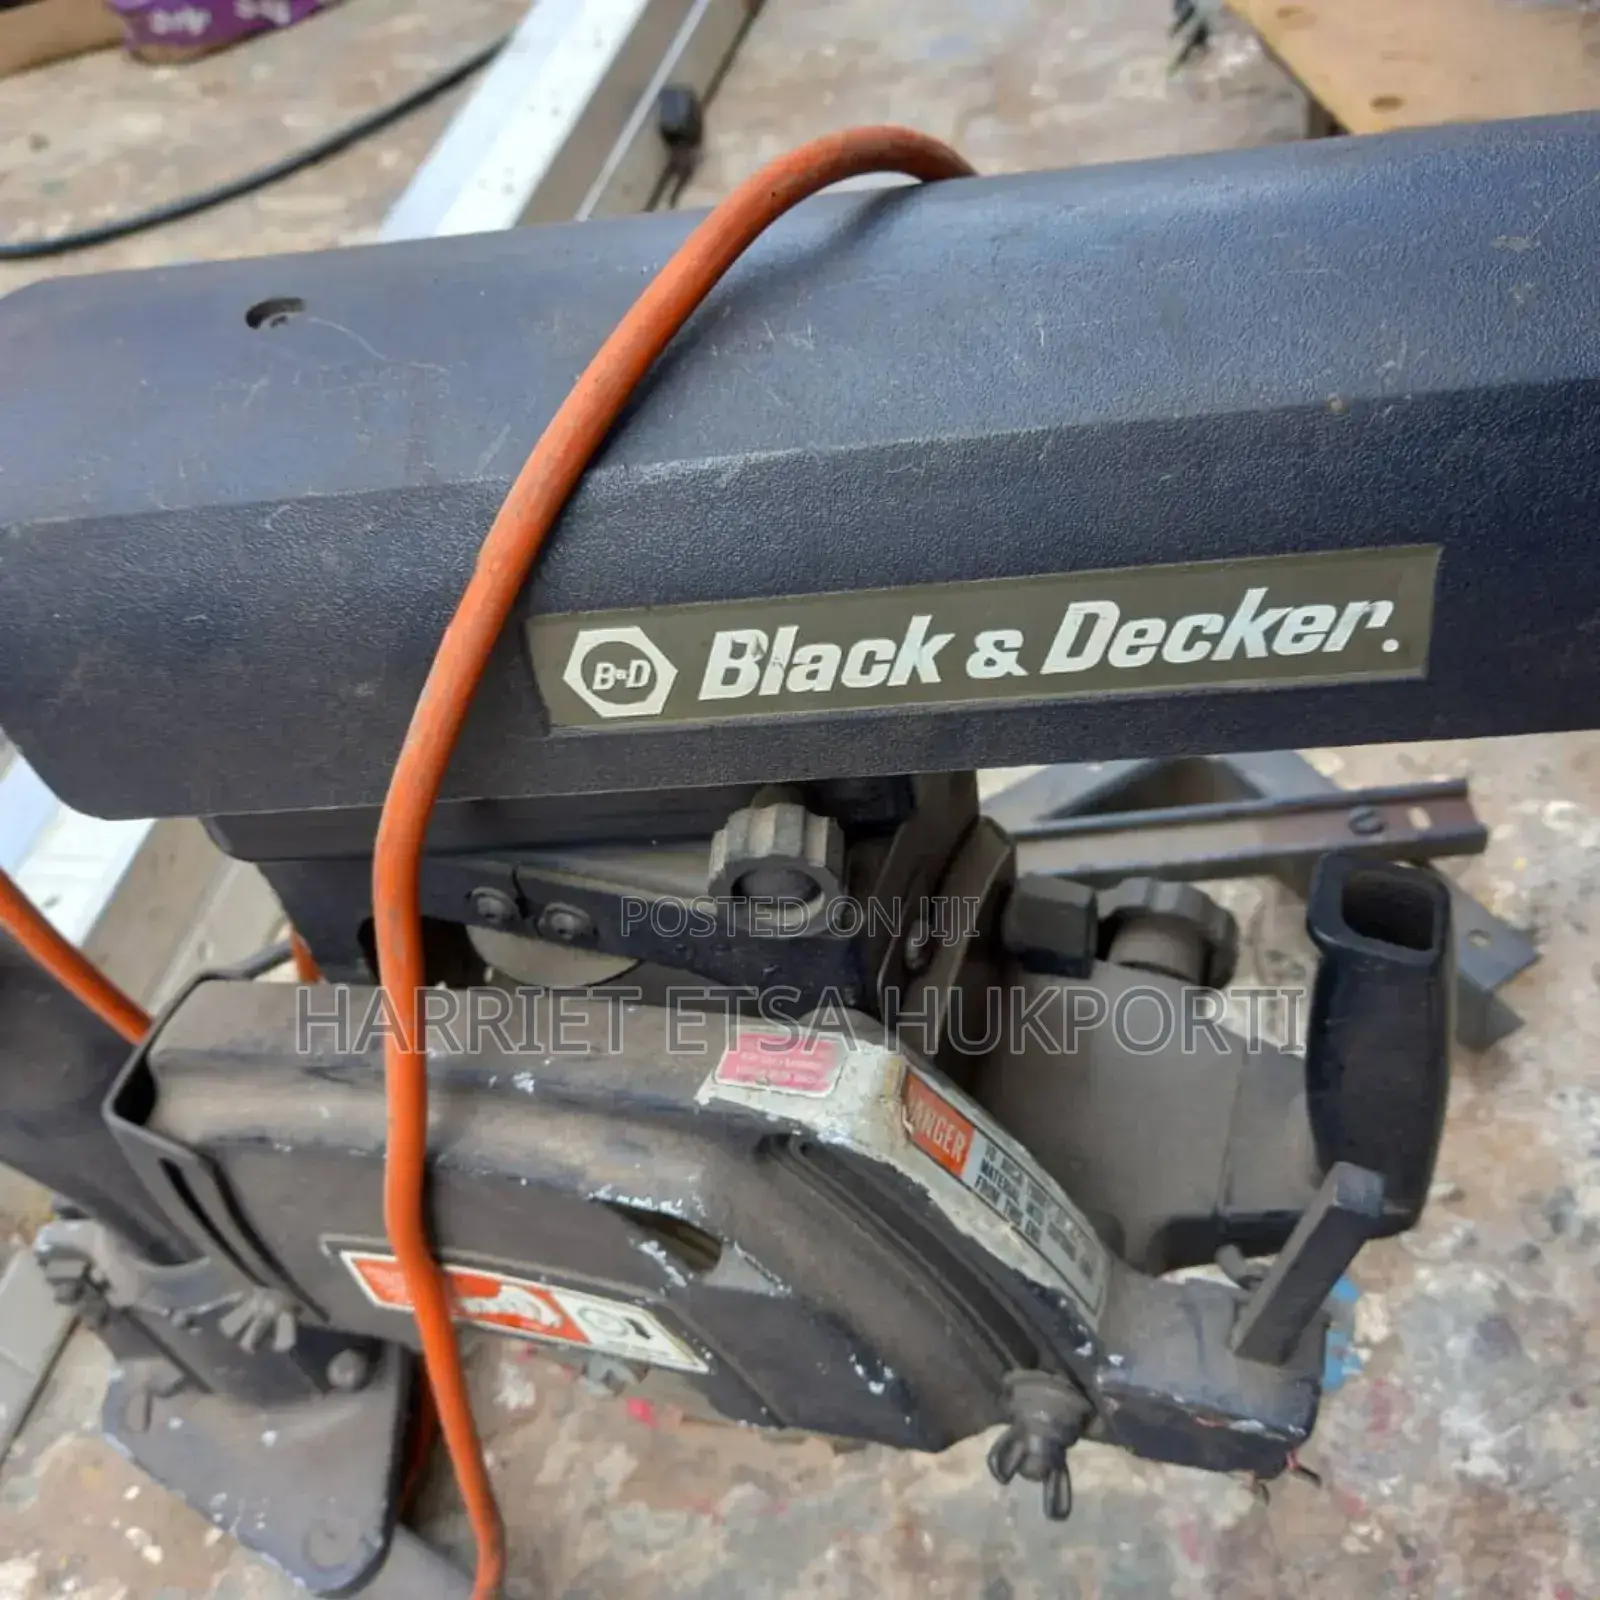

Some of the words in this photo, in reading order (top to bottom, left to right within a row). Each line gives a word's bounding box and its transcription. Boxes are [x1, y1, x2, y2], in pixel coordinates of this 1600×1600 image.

[698, 614, 956, 701] Black
[966, 629, 1029, 679] &
[1040, 587, 1400, 674] Decker.
